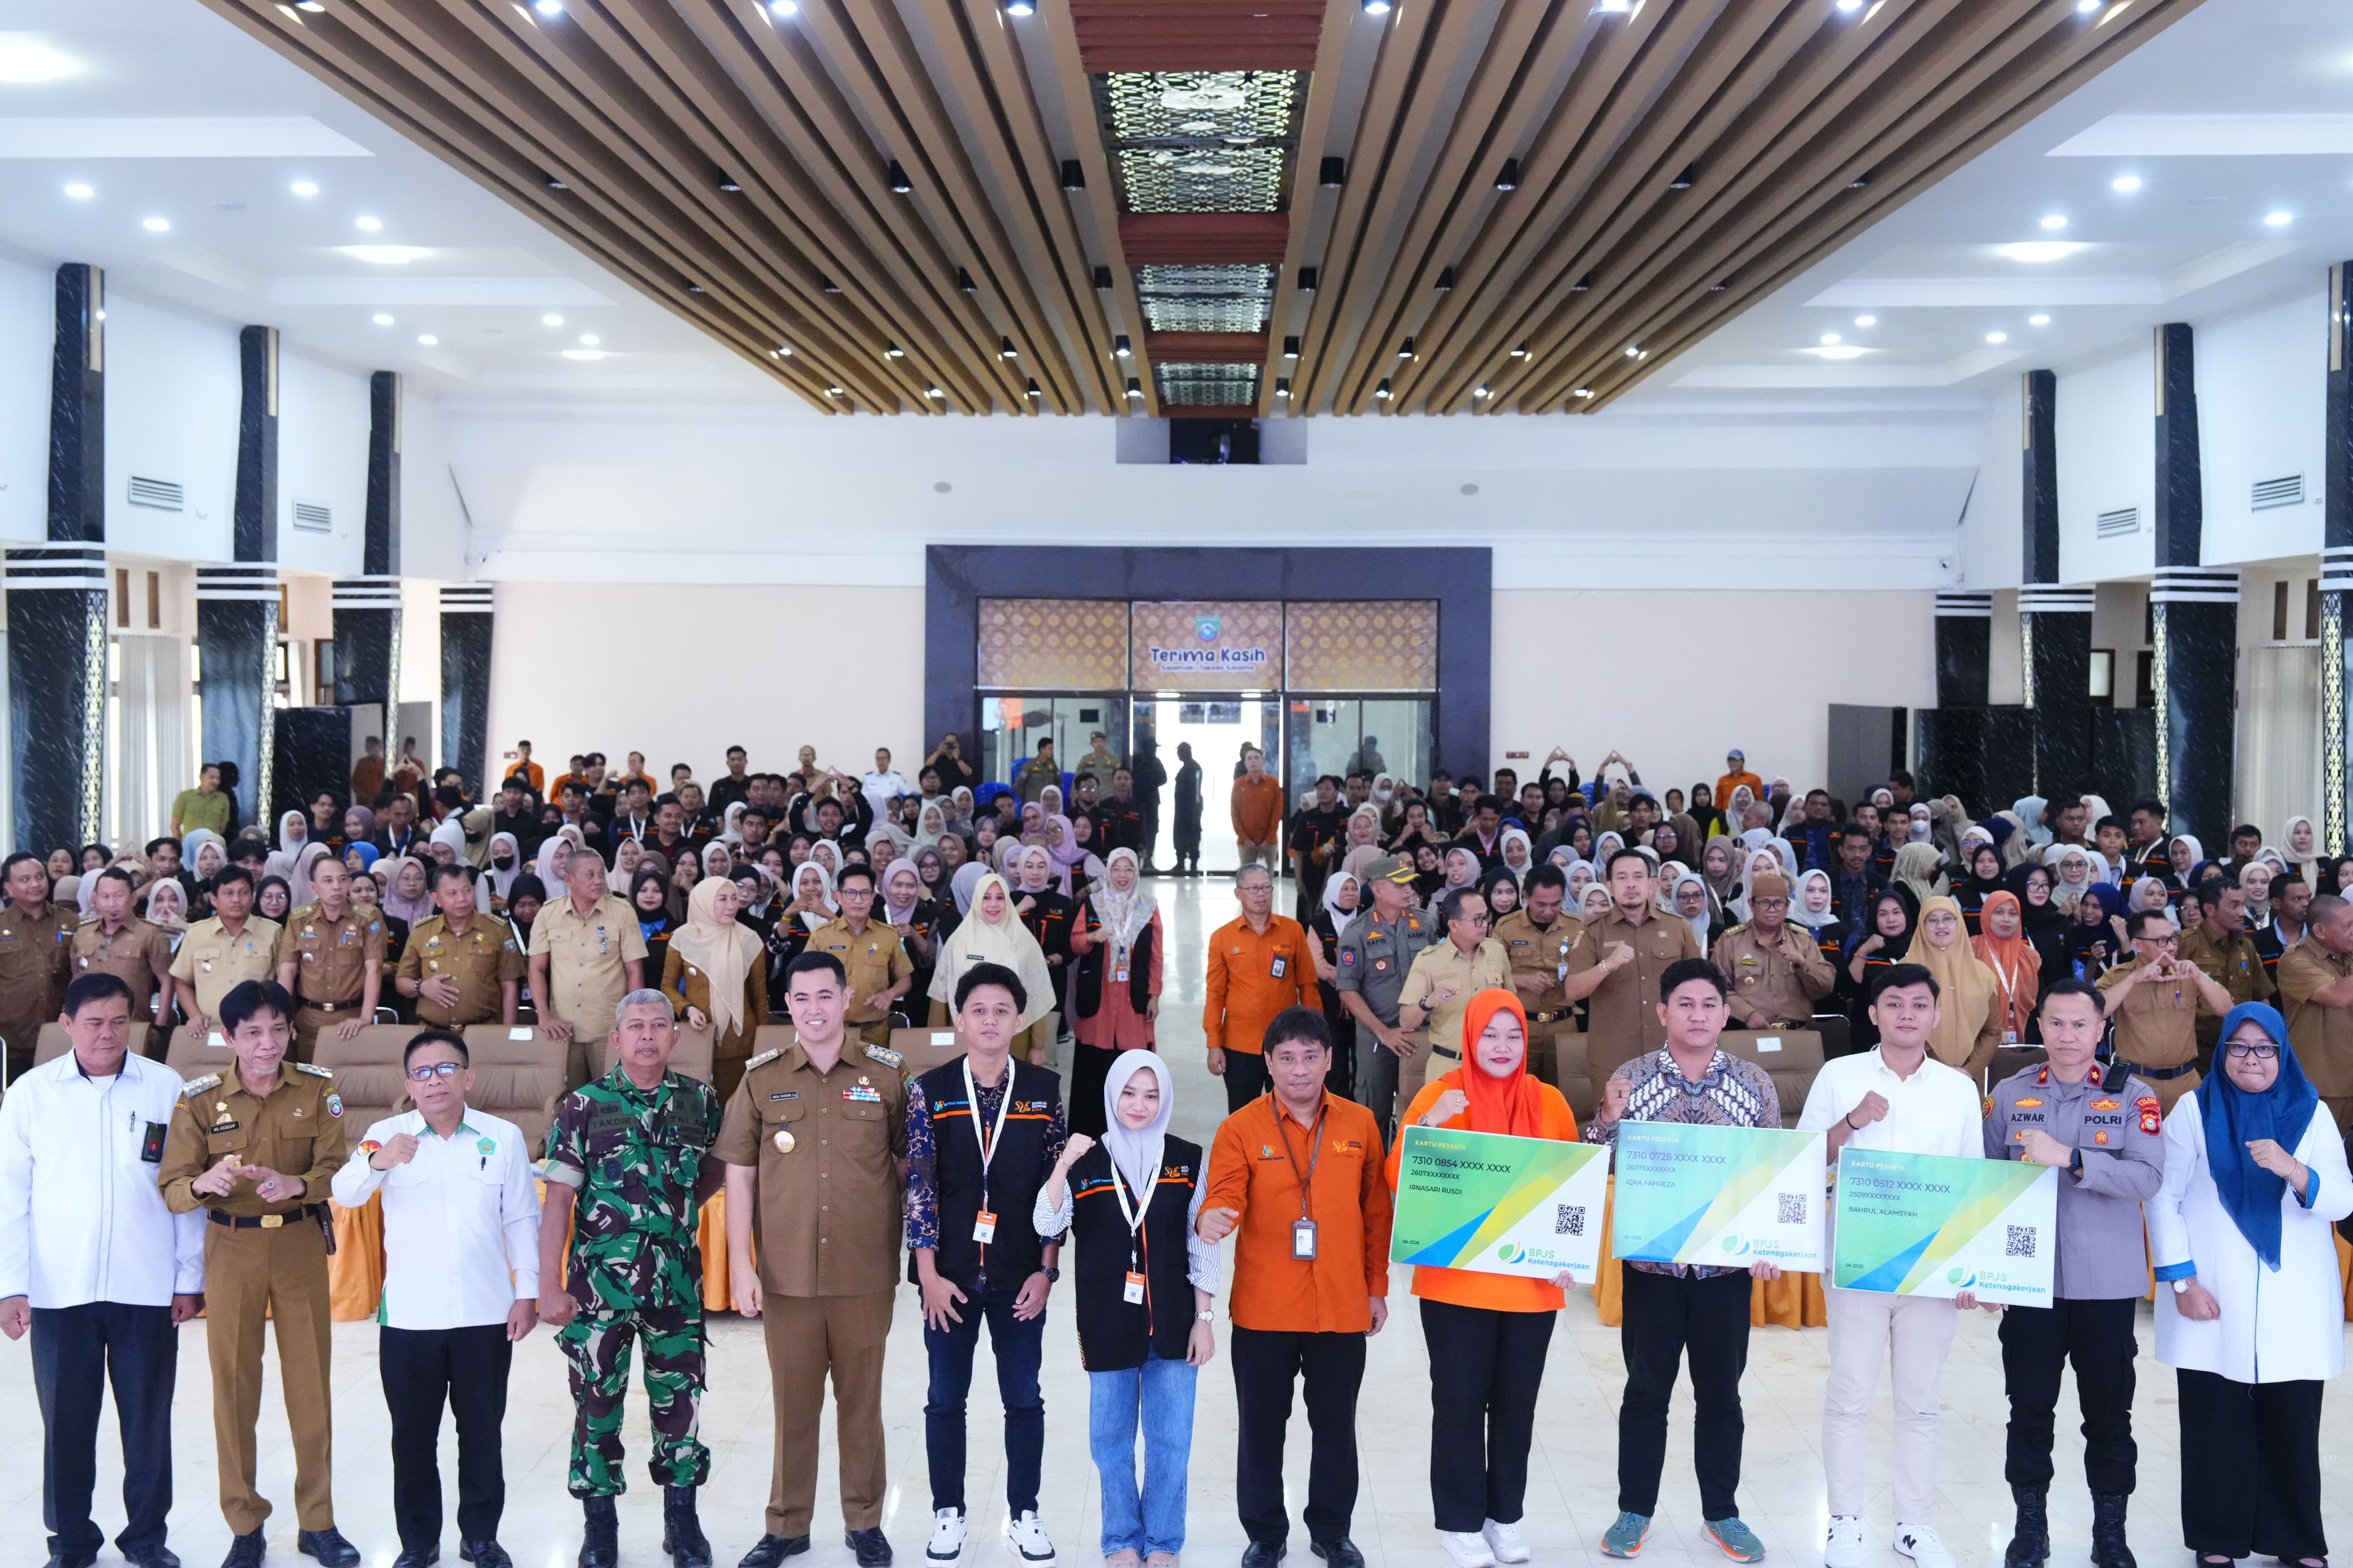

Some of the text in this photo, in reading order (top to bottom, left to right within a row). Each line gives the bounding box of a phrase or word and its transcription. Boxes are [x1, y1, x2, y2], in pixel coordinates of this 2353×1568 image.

[1151, 649, 1265, 662] Terima Kasih
[670, 1116, 689, 1124] TNI
[2011, 1113, 2122, 1125] AZWAR POLRI
[1626, 1151, 1726, 1164] 7310 0728 XXXX XXXX
[1412, 1156, 1511, 1173] 7310 0854 XXXX XXXX
[1409, 1184, 1441, 1193] IRNASARI
[1850, 1177, 1950, 1194] 7310 0512 XXXX XXXX
[1879, 1208, 1918, 1217] ALAMSYAH
[1753, 1238, 1780, 1249] BPJS
[1529, 1248, 1554, 1259] BPJS
[1753, 1248, 1817, 1259] Ketenagakerjaan
[1528, 1258, 1590, 1269] Ketenagakerjaan
[1979, 1271, 2007, 1282] BPJS
[1979, 1281, 2045, 1293] Ketenagakerjaan
